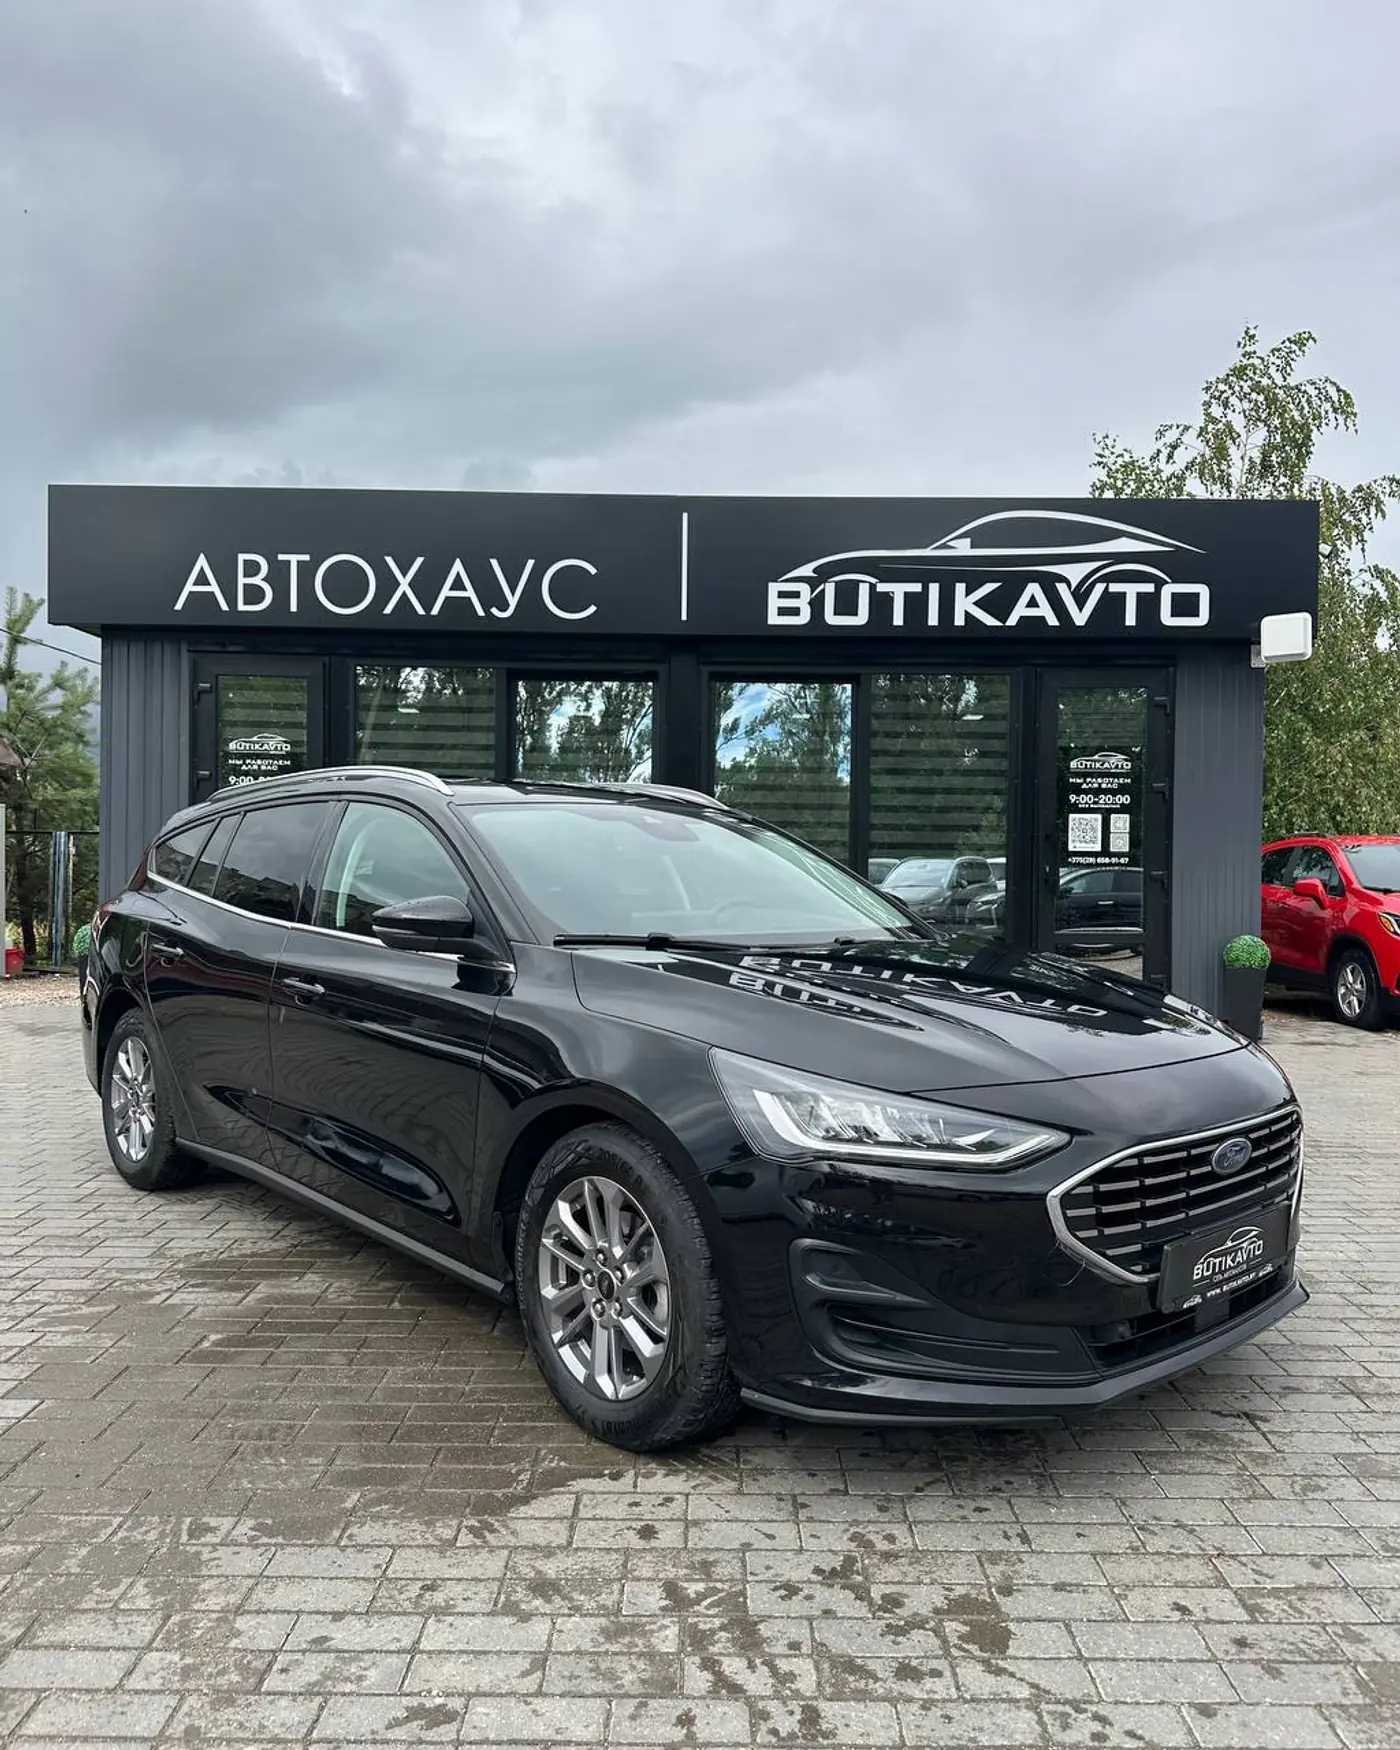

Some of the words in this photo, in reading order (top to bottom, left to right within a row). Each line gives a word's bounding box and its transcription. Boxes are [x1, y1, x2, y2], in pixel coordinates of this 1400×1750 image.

[174, 552, 598, 620] АВТОХАУС
[767, 581, 1211, 627] BUTIKAVTO
[229, 742, 291, 751] BUTIKAVTO
[1070, 761, 1132, 769] BUTIKAVTO
[1069, 794, 1131, 804] 9:00-20:00
[1193, 1240, 1263, 1280] BUTIKAVTO
